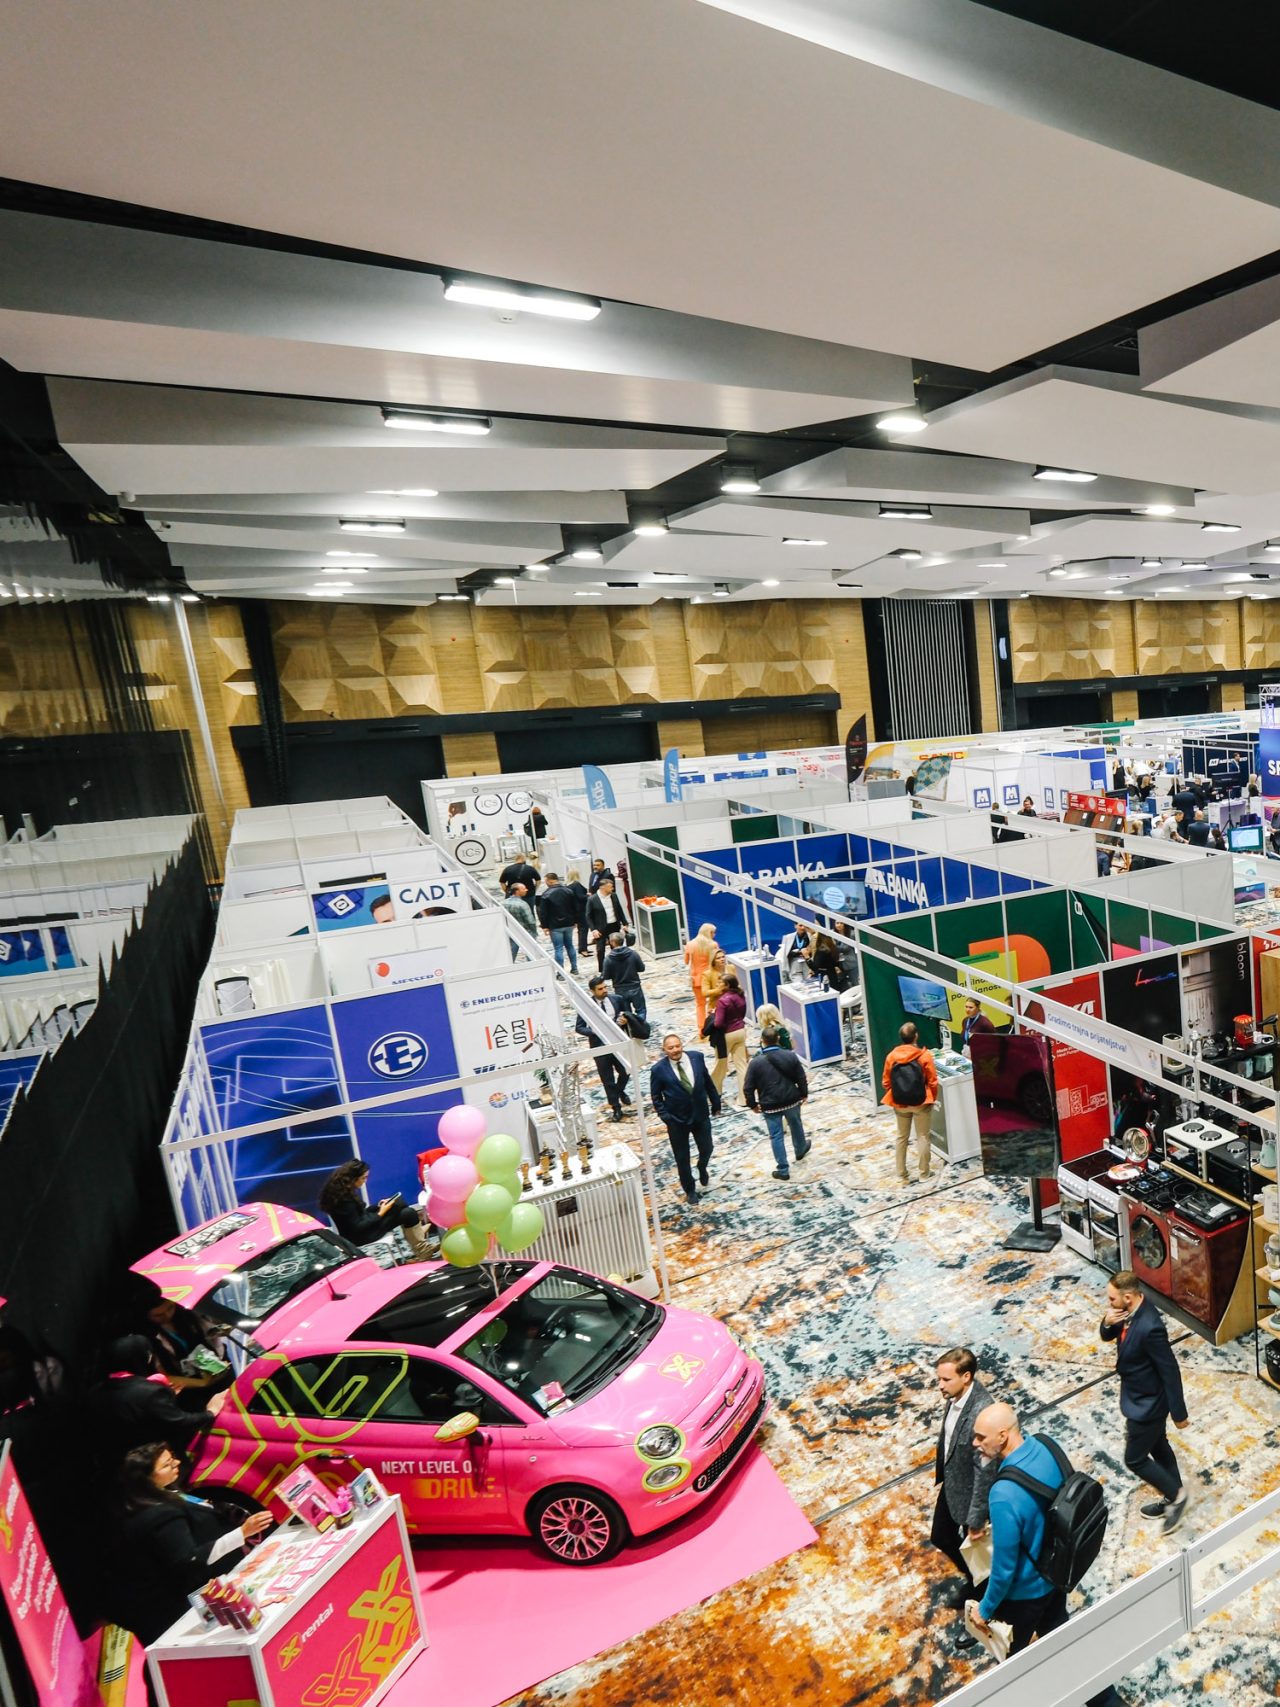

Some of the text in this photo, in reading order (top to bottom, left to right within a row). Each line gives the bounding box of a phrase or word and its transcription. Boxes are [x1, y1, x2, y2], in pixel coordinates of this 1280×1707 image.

[461, 847, 482, 859] ICS
[886, 871, 930, 908] BANKA
[1236, 941, 1246, 982] bloom
[472, 986, 545, 1006] ENERGOINVEST
[381, 1460, 473, 1474] NEXT LEVEL O
[300, 1603, 334, 1643] rental
